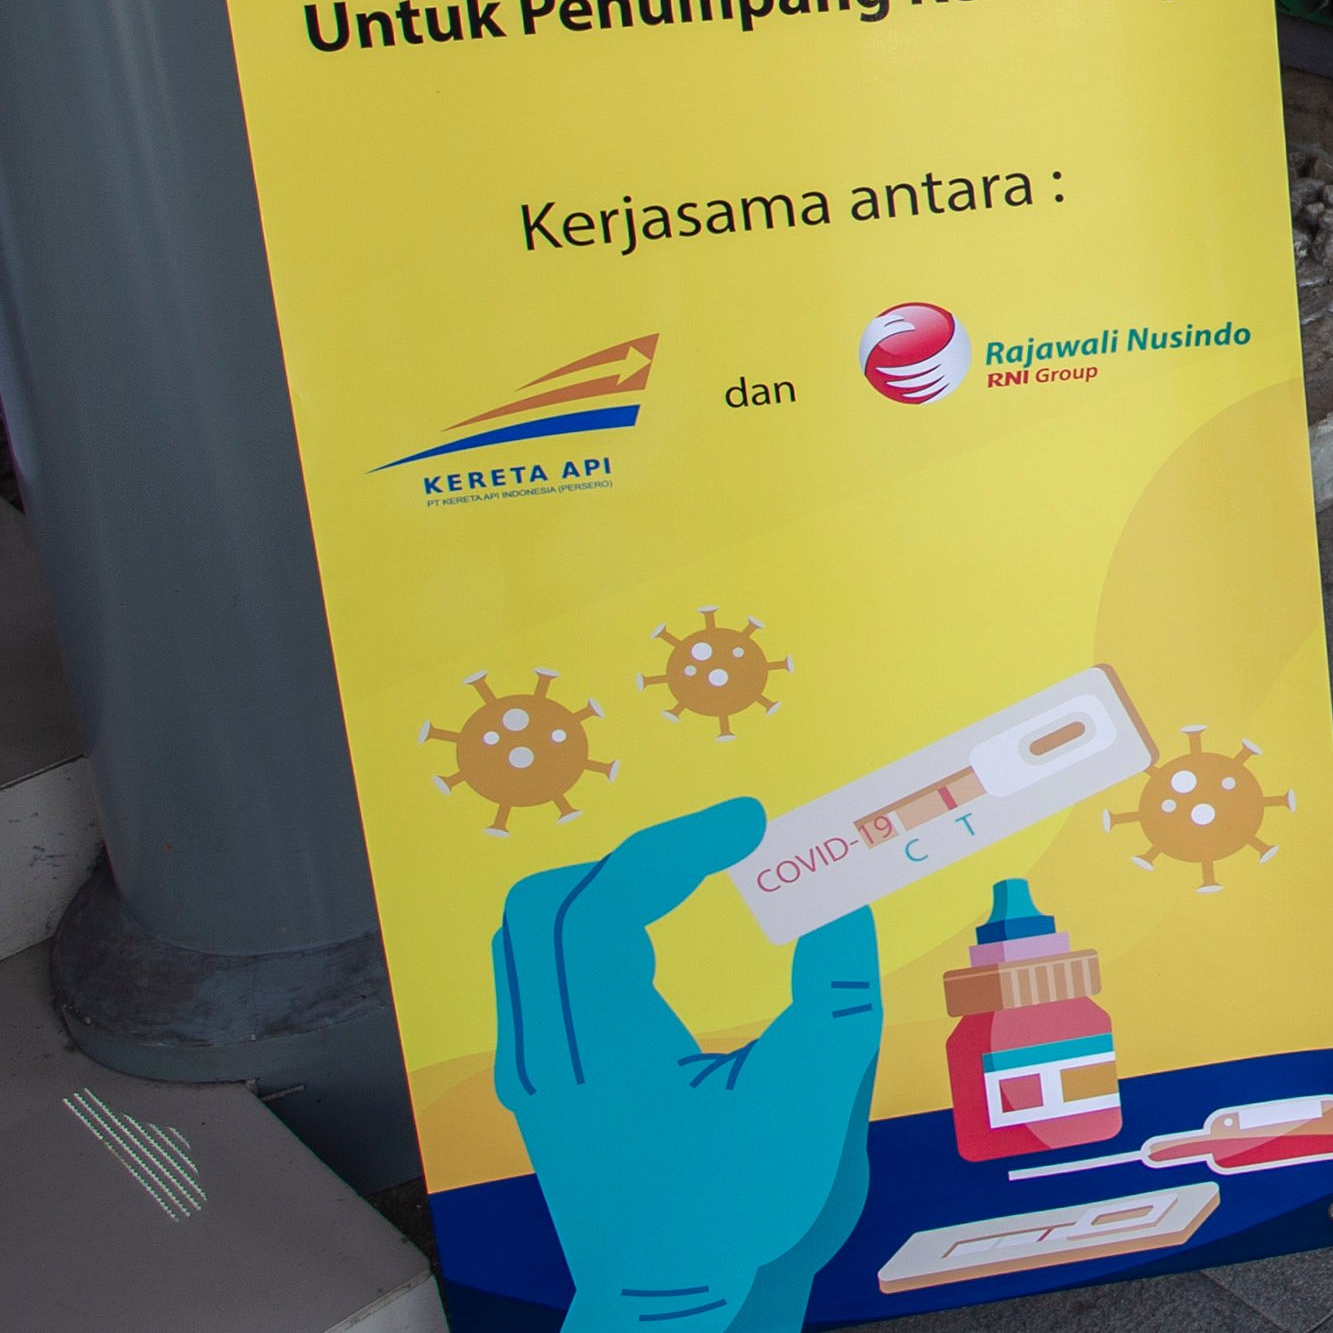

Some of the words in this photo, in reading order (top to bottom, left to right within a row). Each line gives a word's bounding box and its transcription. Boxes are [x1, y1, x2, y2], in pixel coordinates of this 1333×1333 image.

[520, 189, 832, 255] Kerjasama
[849, 167, 1034, 224] antara
[985, 329, 1119, 369] Rajawali
[1127, 321, 1252, 352] Nusindo
[724, 375, 797, 410] dan
[986, 369, 1029, 388] RNI
[1035, 366, 1099, 384] Group
[423, 464, 549, 495] KERETA
[561, 457, 612, 479] API
[427, 499, 440, 508] PT
[442, 494, 482, 507] KERETA
[483, 492, 500, 501] API
[503, 486, 557, 499] INDONESIA
[558, 479, 614, 495] (PERSERO)
[755, 811, 897, 895] COVID-19
[903, 839, 931, 866] C
[953, 811, 981, 841] T
